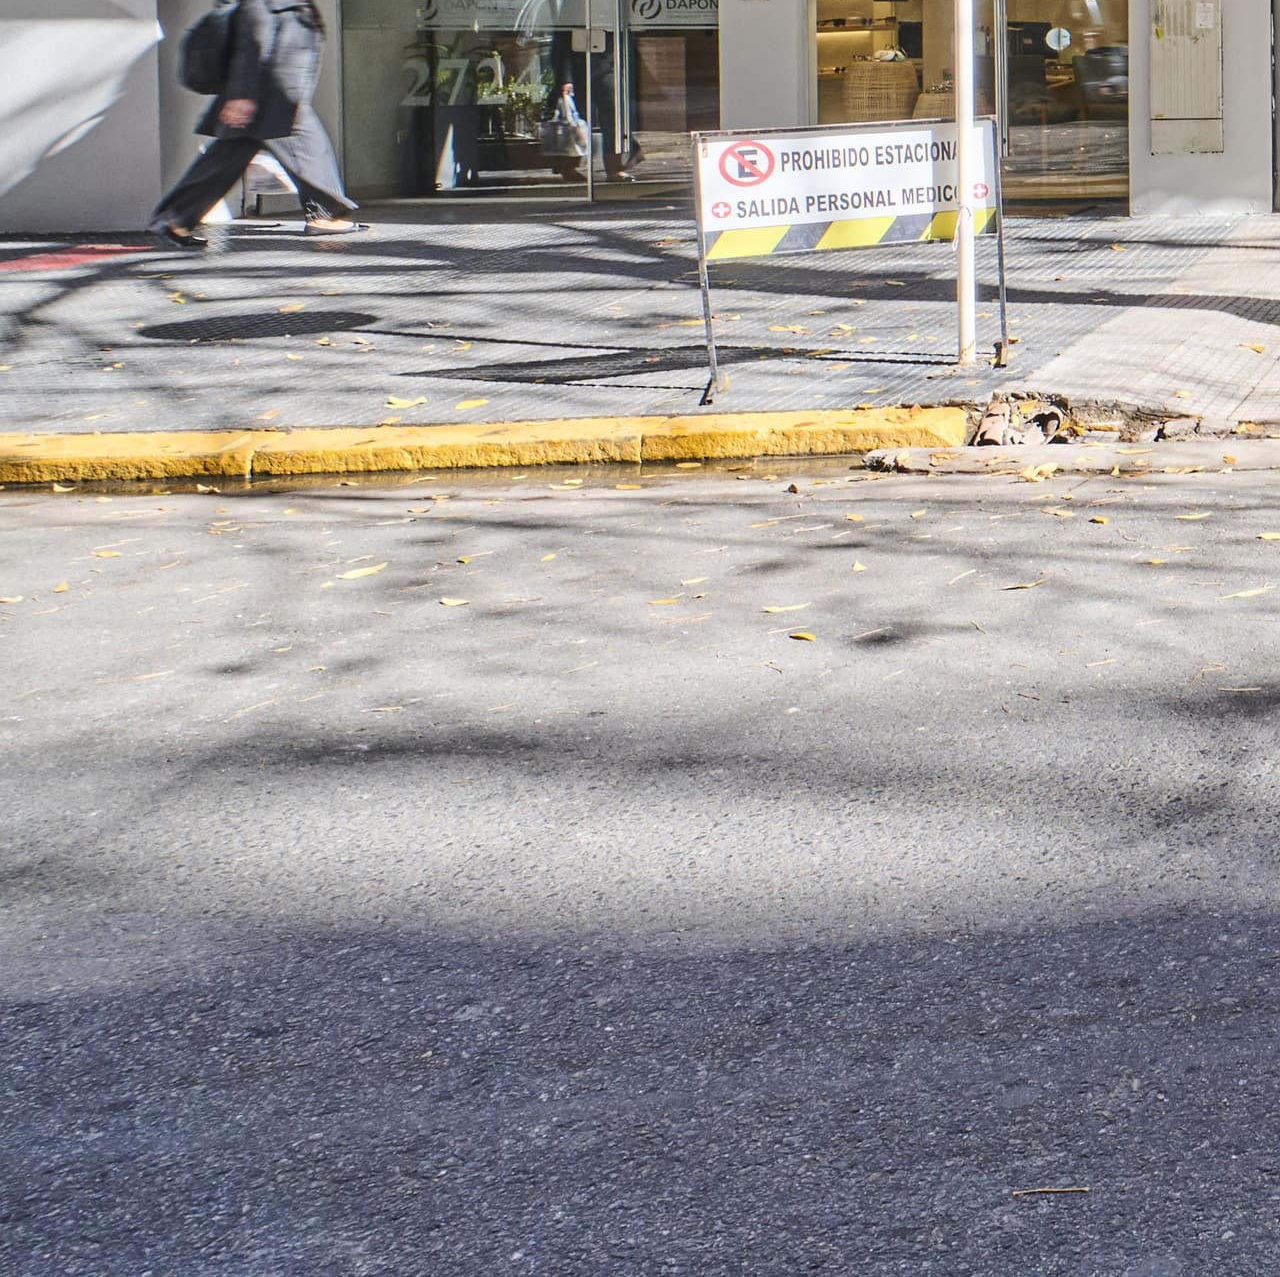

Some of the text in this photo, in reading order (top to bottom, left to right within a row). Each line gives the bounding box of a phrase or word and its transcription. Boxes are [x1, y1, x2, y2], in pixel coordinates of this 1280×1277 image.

[780, 146, 870, 173] PROHIBIDO
[736, 197, 800, 219] SALIDA
[805, 189, 896, 213] PERSONAL
